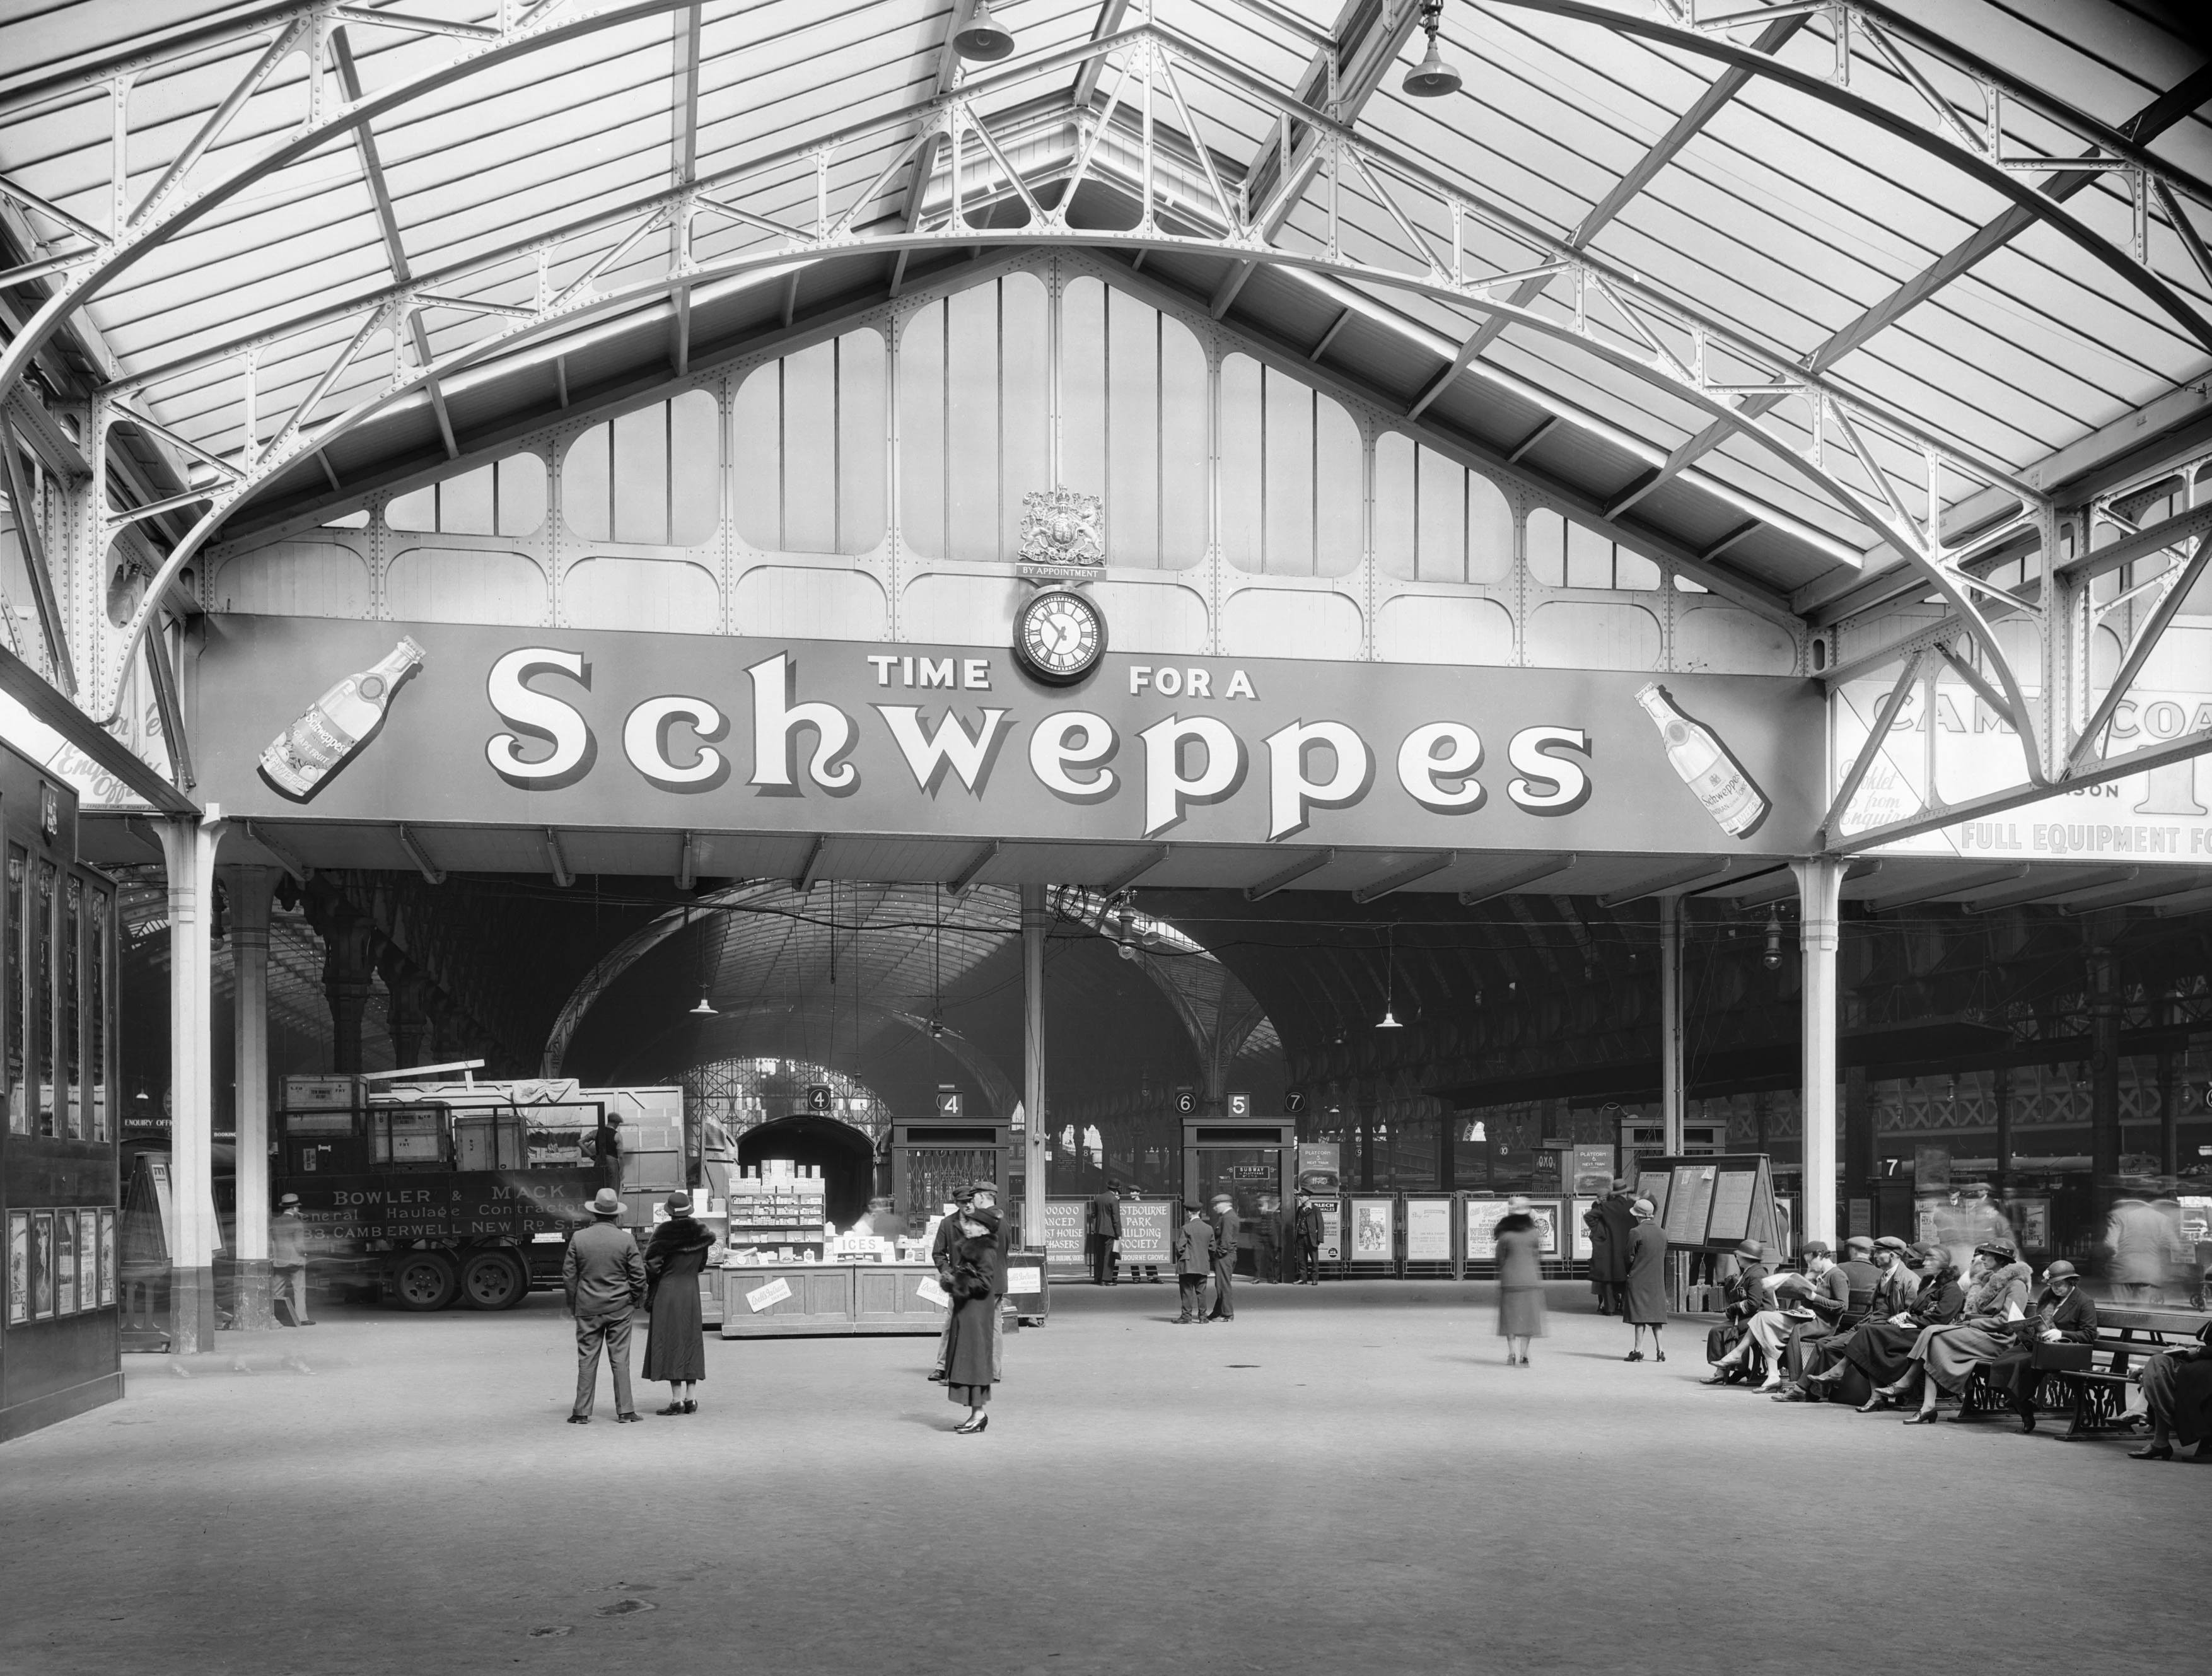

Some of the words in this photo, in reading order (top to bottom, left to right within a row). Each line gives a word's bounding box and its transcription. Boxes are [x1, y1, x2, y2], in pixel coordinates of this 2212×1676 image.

[1036, 567, 1098, 578] APPOINTMENT
[867, 655, 989, 689] TIME
[1130, 666, 1210, 697] FOR
[1226, 670, 1255, 698] A
[306, 711, 346, 753] Schweppes
[293, 730, 312, 751] GRAPE
[310, 748, 330, 764] FRUIT
[486, 648, 1591, 840] Schweppes
[1701, 772, 1741, 807] Schweppes
[2066, 785, 2119, 798] SON
[1709, 803, 1730, 815] INDIAN
[1863, 790, 1901, 813] from
[1841, 809, 1917, 830] Enquir
[1962, 822, 2022, 850] FULL
[2033, 823, 2180, 854] EQUIPMENT
[814, 1091, 824, 1107] 4
[945, 1096, 958, 1114] 4
[1180, 1095, 1190, 1110] 6
[1232, 1096, 1245, 1114] 5
[1290, 1095, 1300, 1110] 7
[1539, 1155, 1553, 1168] OXO
[1886, 1159, 1898, 1177] 7
[334, 1190, 431, 1205] BOWLER
[451, 1190, 462, 1201] &
[492, 1185, 565, 1199] MACK
[300, 1209, 359, 1222] eneral
[387, 1206, 460, 1219] Haulage
[479, 1201, 585, 1215] Contractor
[1045, 1206, 1080, 1215] 00,000
[1119, 1205, 1168, 1215] ESTBOURNE
[1125, 1216, 1153, 1226] PARK
[334, 1223, 462, 1238] CAMBERWELL
[472, 1221, 512, 1233] NEW
[1057, 1229, 1083, 1237] HOUSE
[1122, 1228, 1161, 1239] UILDING
[1469, 1228, 1494, 1237] WEST
[842, 1240, 876, 1250] ICES
[1121, 1239, 1159, 1249] SOCIETY
